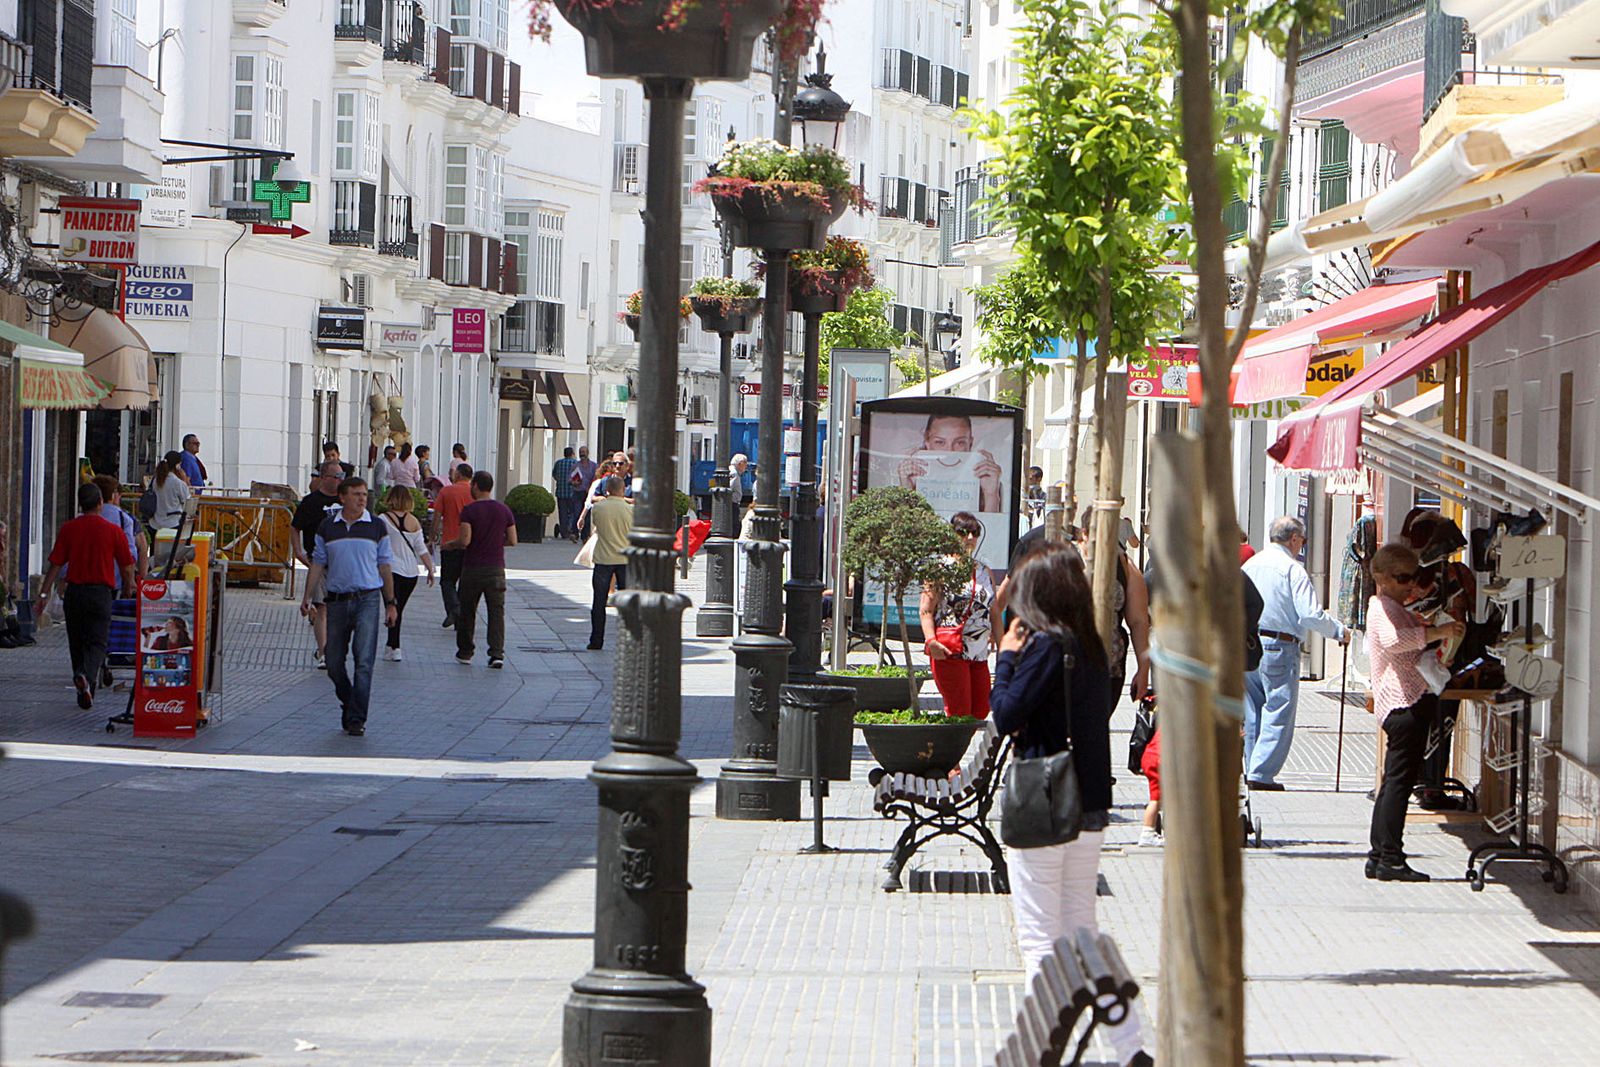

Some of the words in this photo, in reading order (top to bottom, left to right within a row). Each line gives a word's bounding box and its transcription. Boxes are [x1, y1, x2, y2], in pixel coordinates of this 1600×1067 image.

[151, 188, 186, 200] URBANISMO
[64, 211, 136, 232] PANADERIA
[89, 240, 136, 259] BUTRON
[126, 282, 183, 299] iego
[457, 312, 481, 324] LEO
[383, 329, 418, 343] katia
[1129, 371, 1159, 379] VELAS
